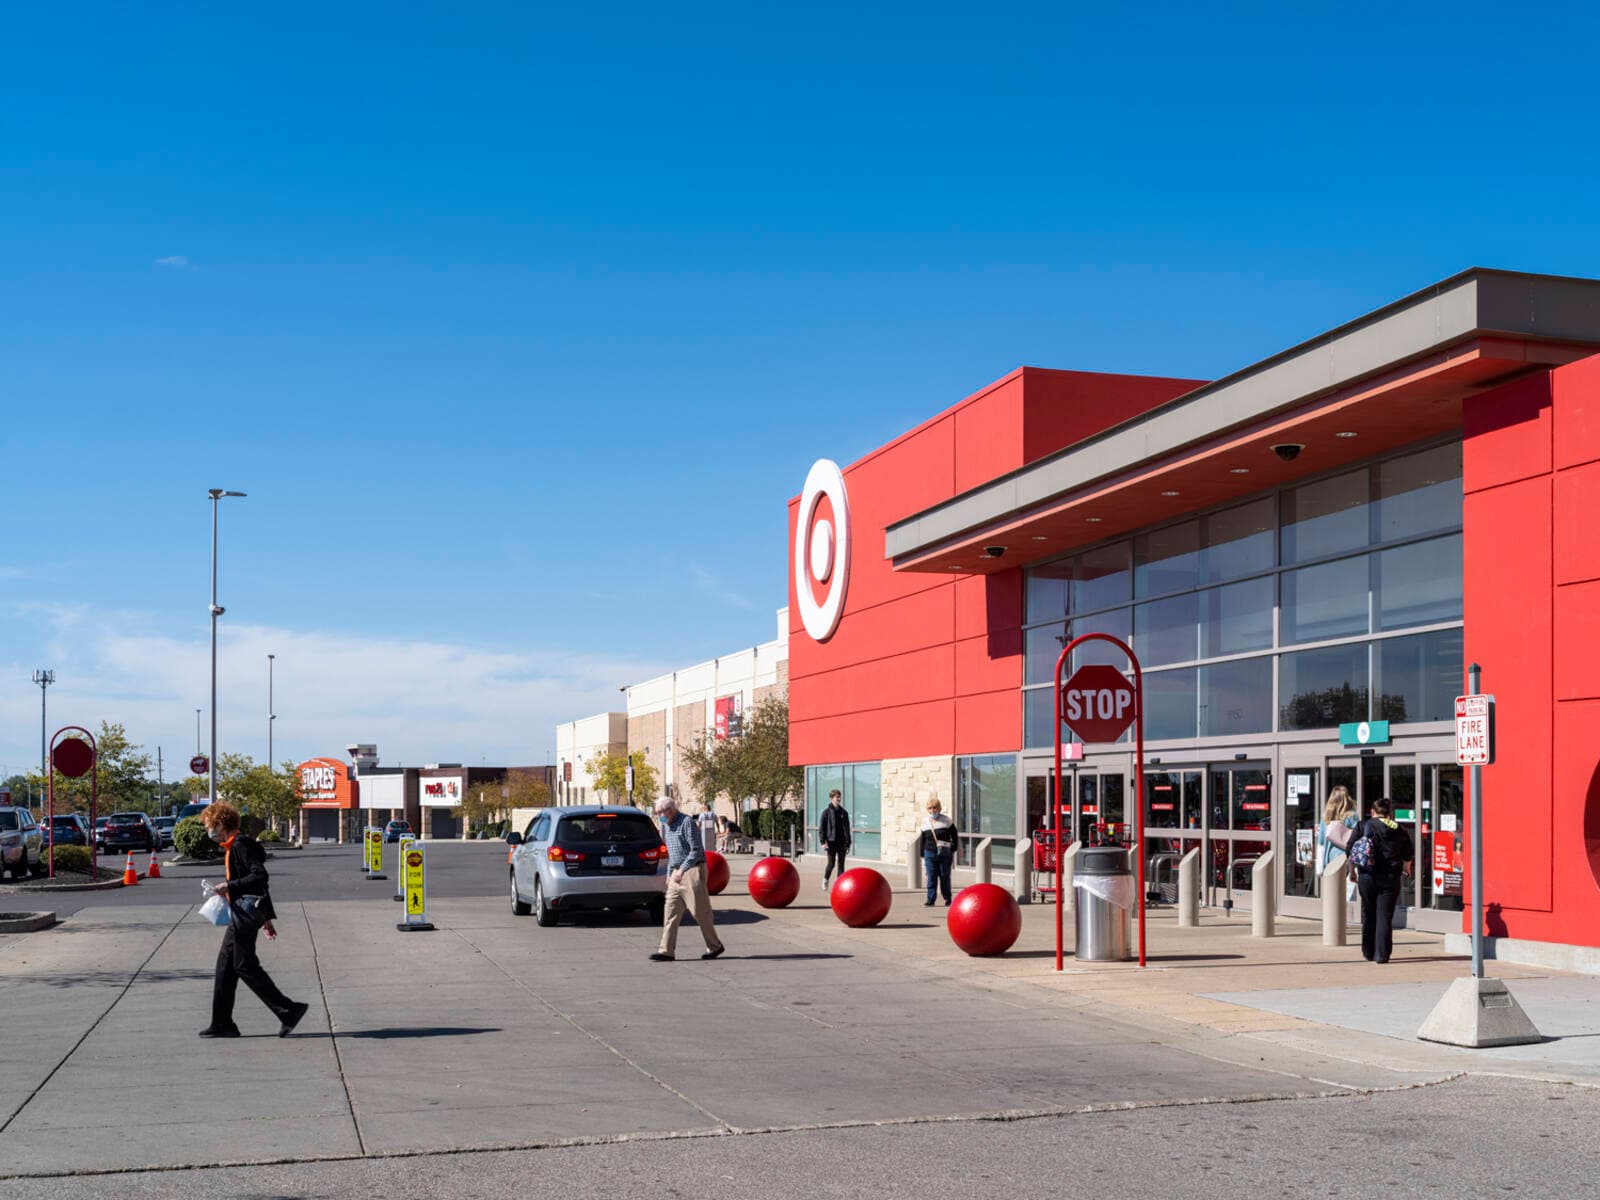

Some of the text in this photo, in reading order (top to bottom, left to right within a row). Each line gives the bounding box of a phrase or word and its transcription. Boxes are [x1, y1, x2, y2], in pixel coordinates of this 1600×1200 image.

[1067, 689, 1131, 720] STOP
[1457, 701, 1466, 713] NO
[1461, 720, 1482, 734] FIRE
[1460, 736, 1484, 749] LANE
[302, 767, 336, 790] STAPLES
